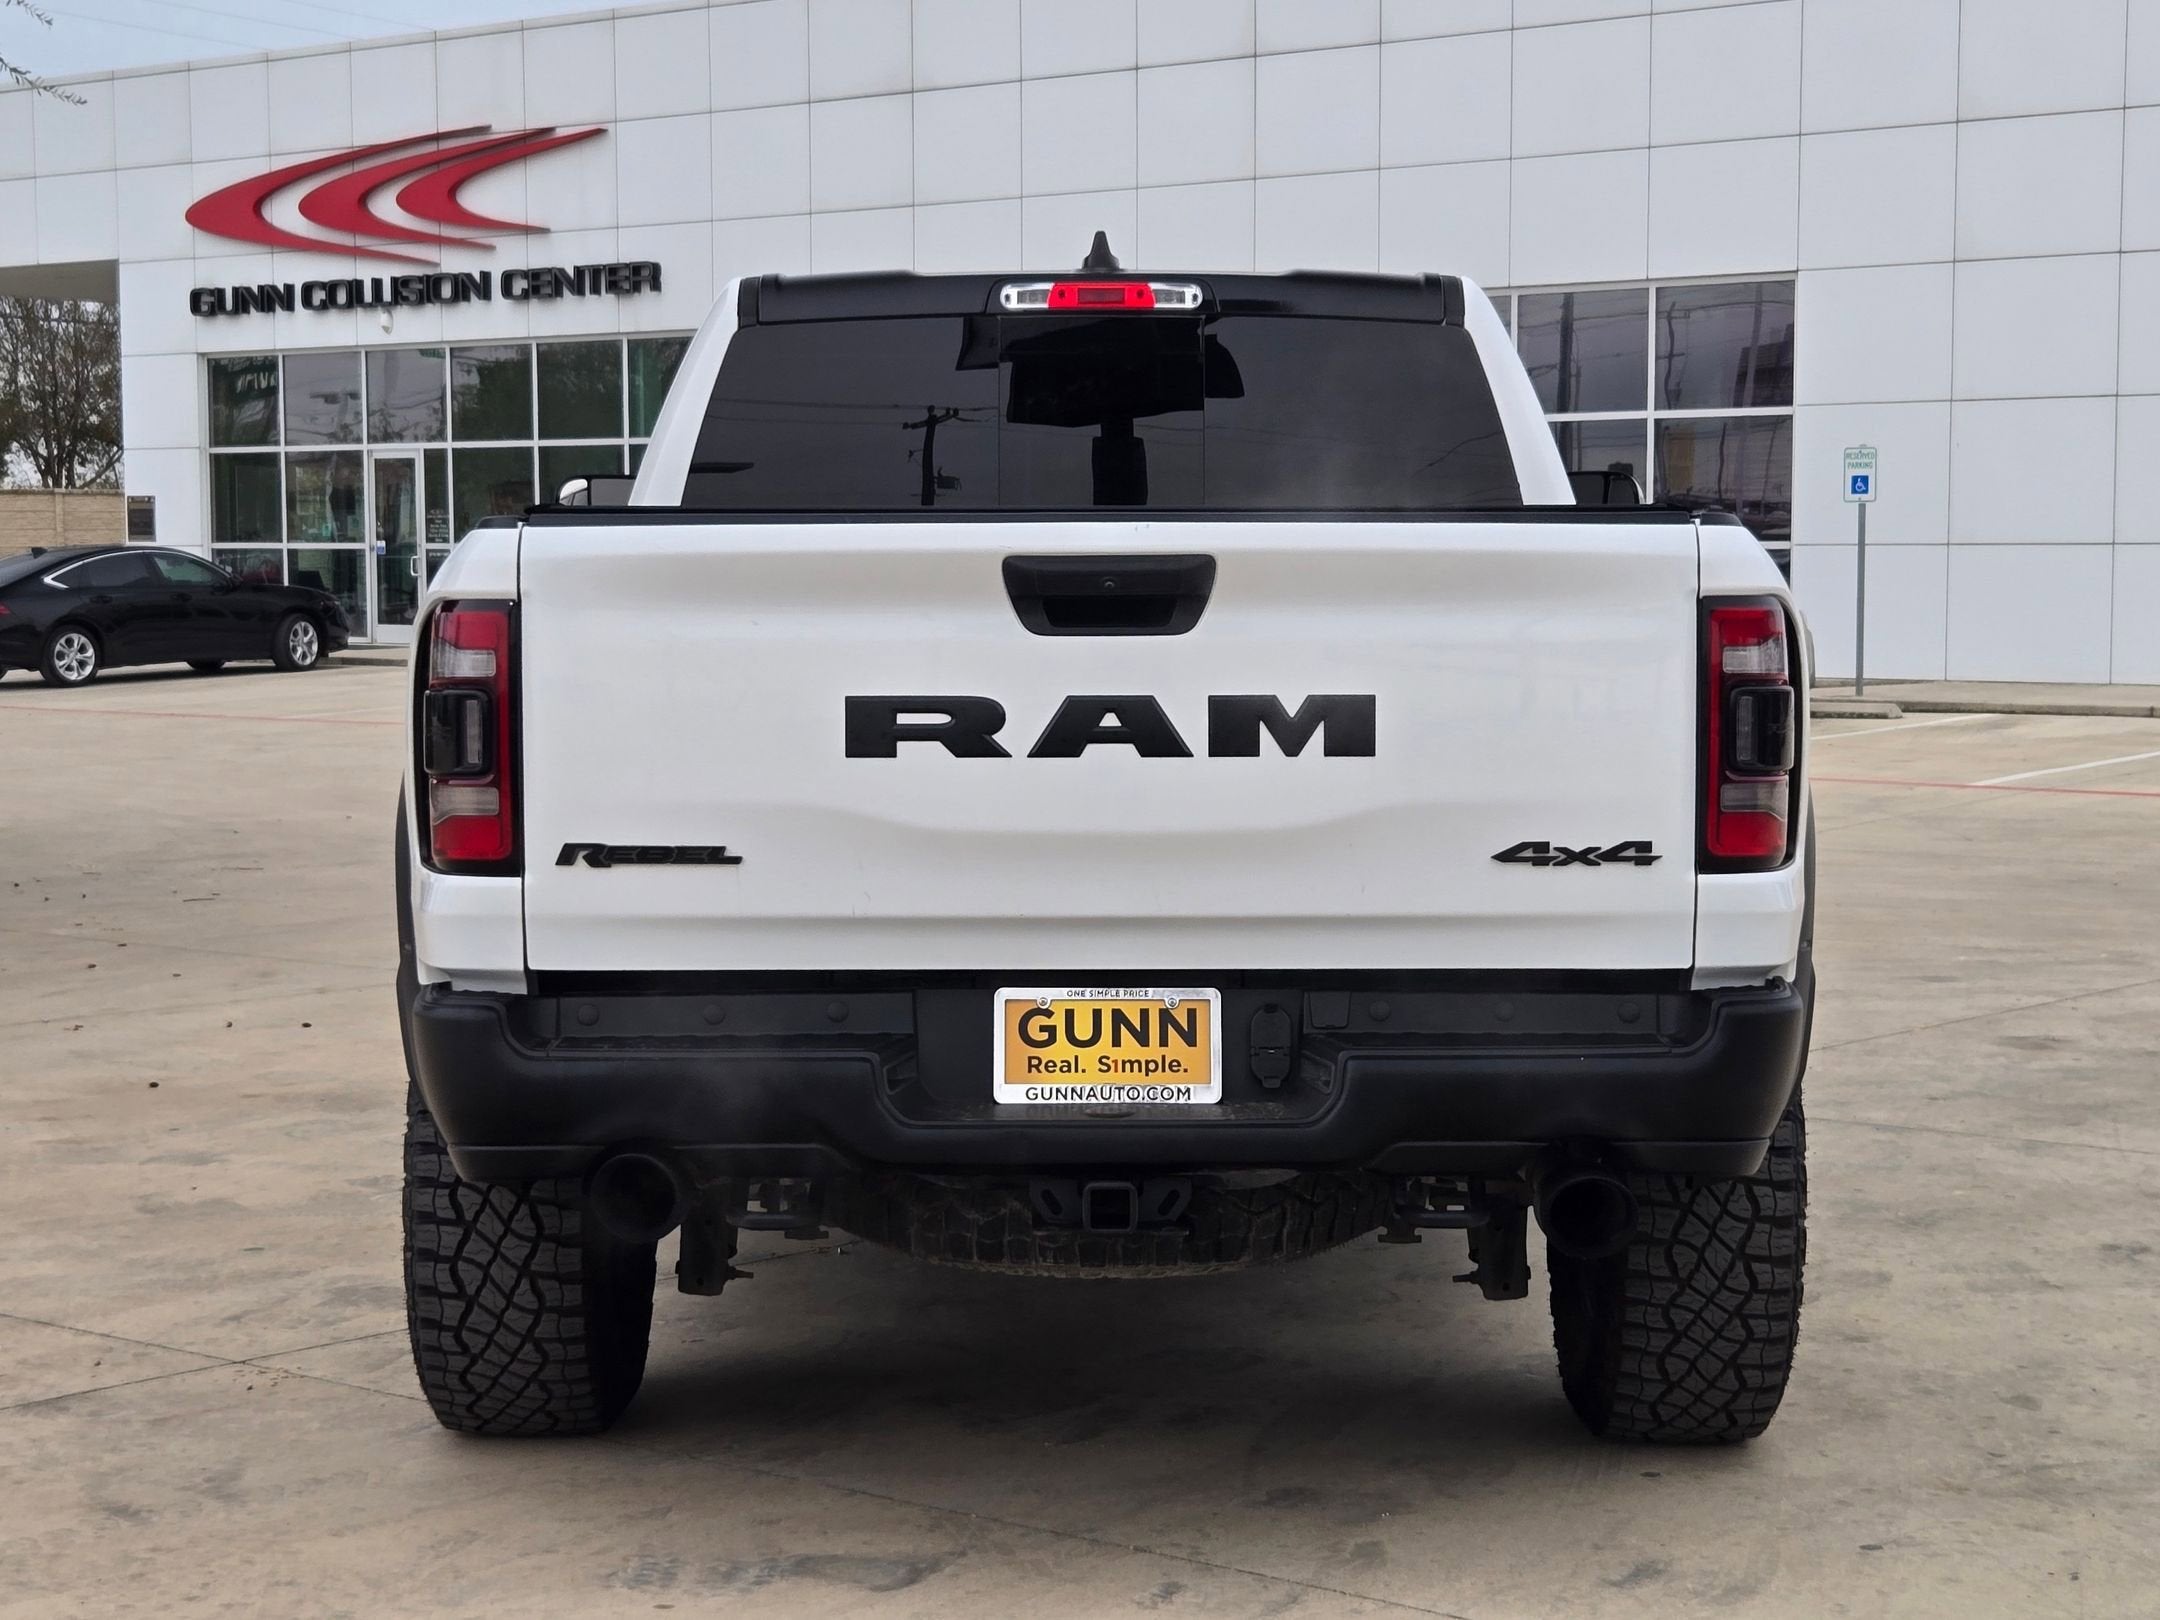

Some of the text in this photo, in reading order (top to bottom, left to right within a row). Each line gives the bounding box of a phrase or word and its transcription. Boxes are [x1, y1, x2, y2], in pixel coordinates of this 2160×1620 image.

[190, 261, 662, 316] GUNN COLLISION CENTER
[1846, 452, 1875, 460] RESERVED
[1847, 461, 1873, 469] PARKING
[845, 694, 1376, 758] RAM
[555, 842, 743, 868] REBEL
[1066, 990, 1150, 998] ONE SIMPLE PRICE
[1018, 1007, 1198, 1049] GUNN
[1027, 1055, 1087, 1074] Real.
[1025, 1086, 1191, 1102] GUNNAUTO.COM
